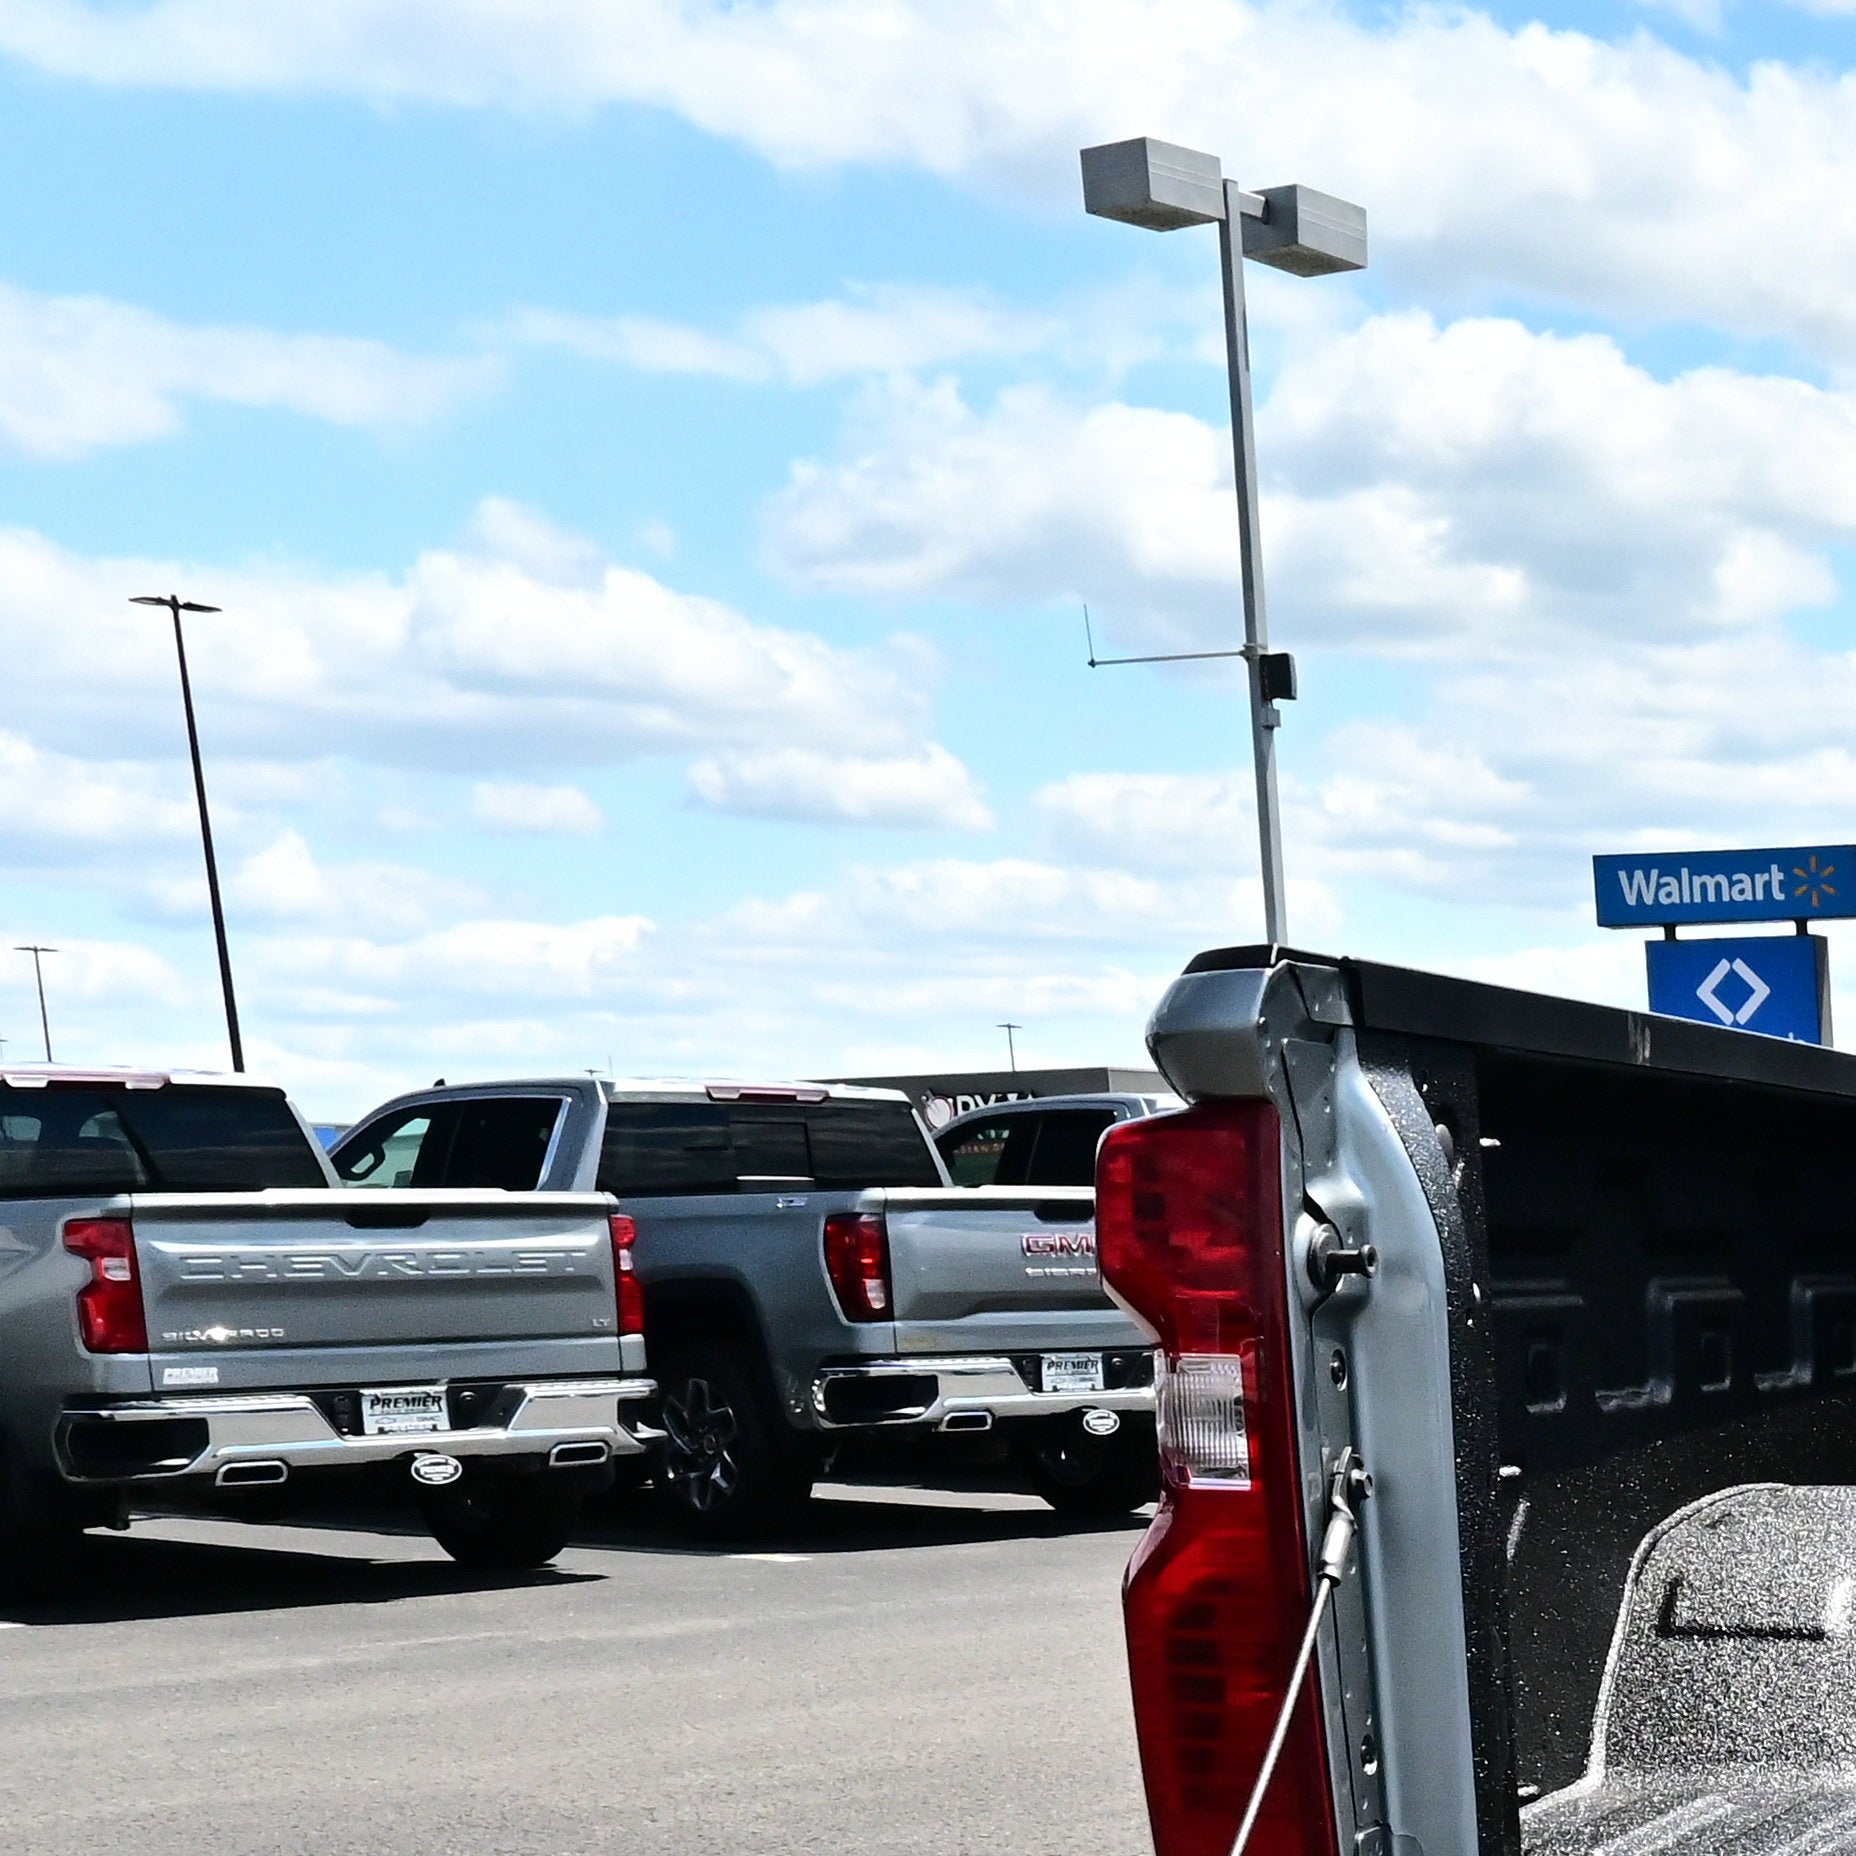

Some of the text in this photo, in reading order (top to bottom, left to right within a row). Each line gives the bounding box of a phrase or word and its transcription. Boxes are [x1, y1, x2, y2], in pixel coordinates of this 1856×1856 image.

[1617, 863, 1786, 907] Walmart
[1021, 1233, 1097, 1257] GM
[179, 1249, 587, 1281] CHEVROLET
[1046, 1360, 1099, 1371] PREMIER
[369, 1395, 443, 1411] PREMIER
